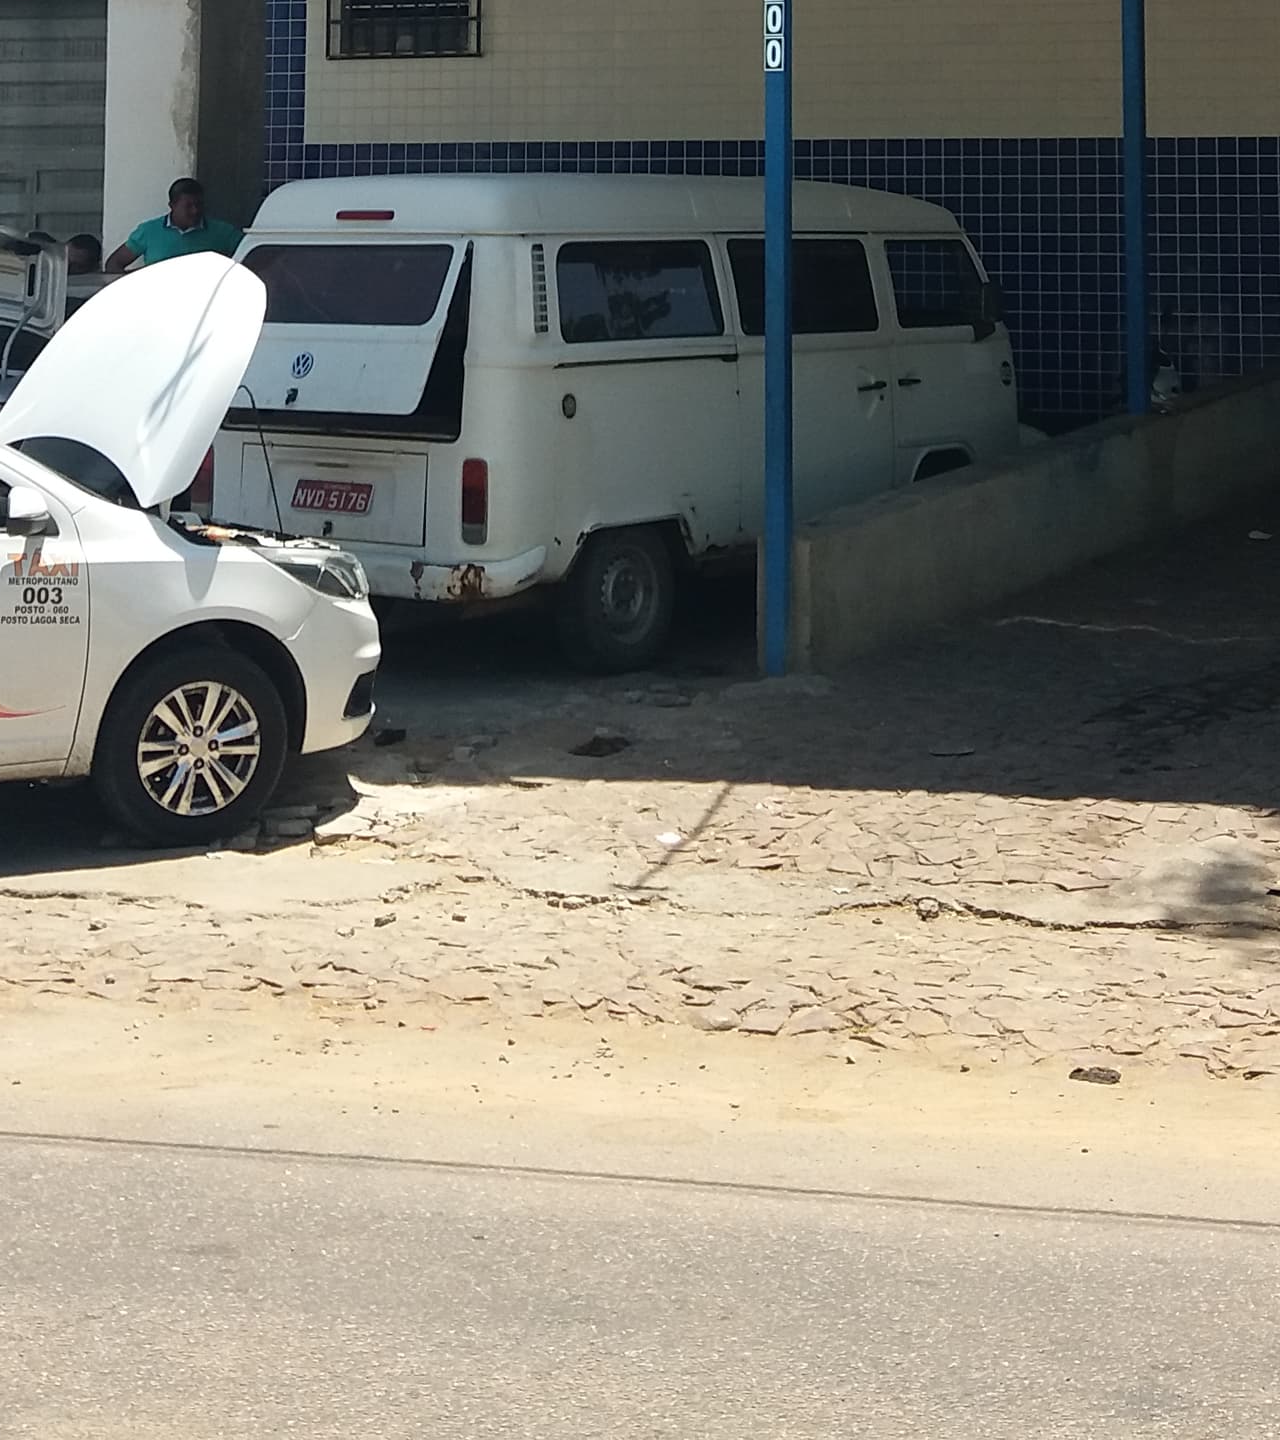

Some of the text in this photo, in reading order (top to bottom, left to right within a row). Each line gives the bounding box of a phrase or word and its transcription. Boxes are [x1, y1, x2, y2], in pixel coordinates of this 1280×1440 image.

[8, 577, 79, 586] METROPOLITANO
[23, 587, 63, 605] 003
[14, 606, 45, 614] POSTO
[0, 616, 81, 625] POSTO LAGOA SECA
